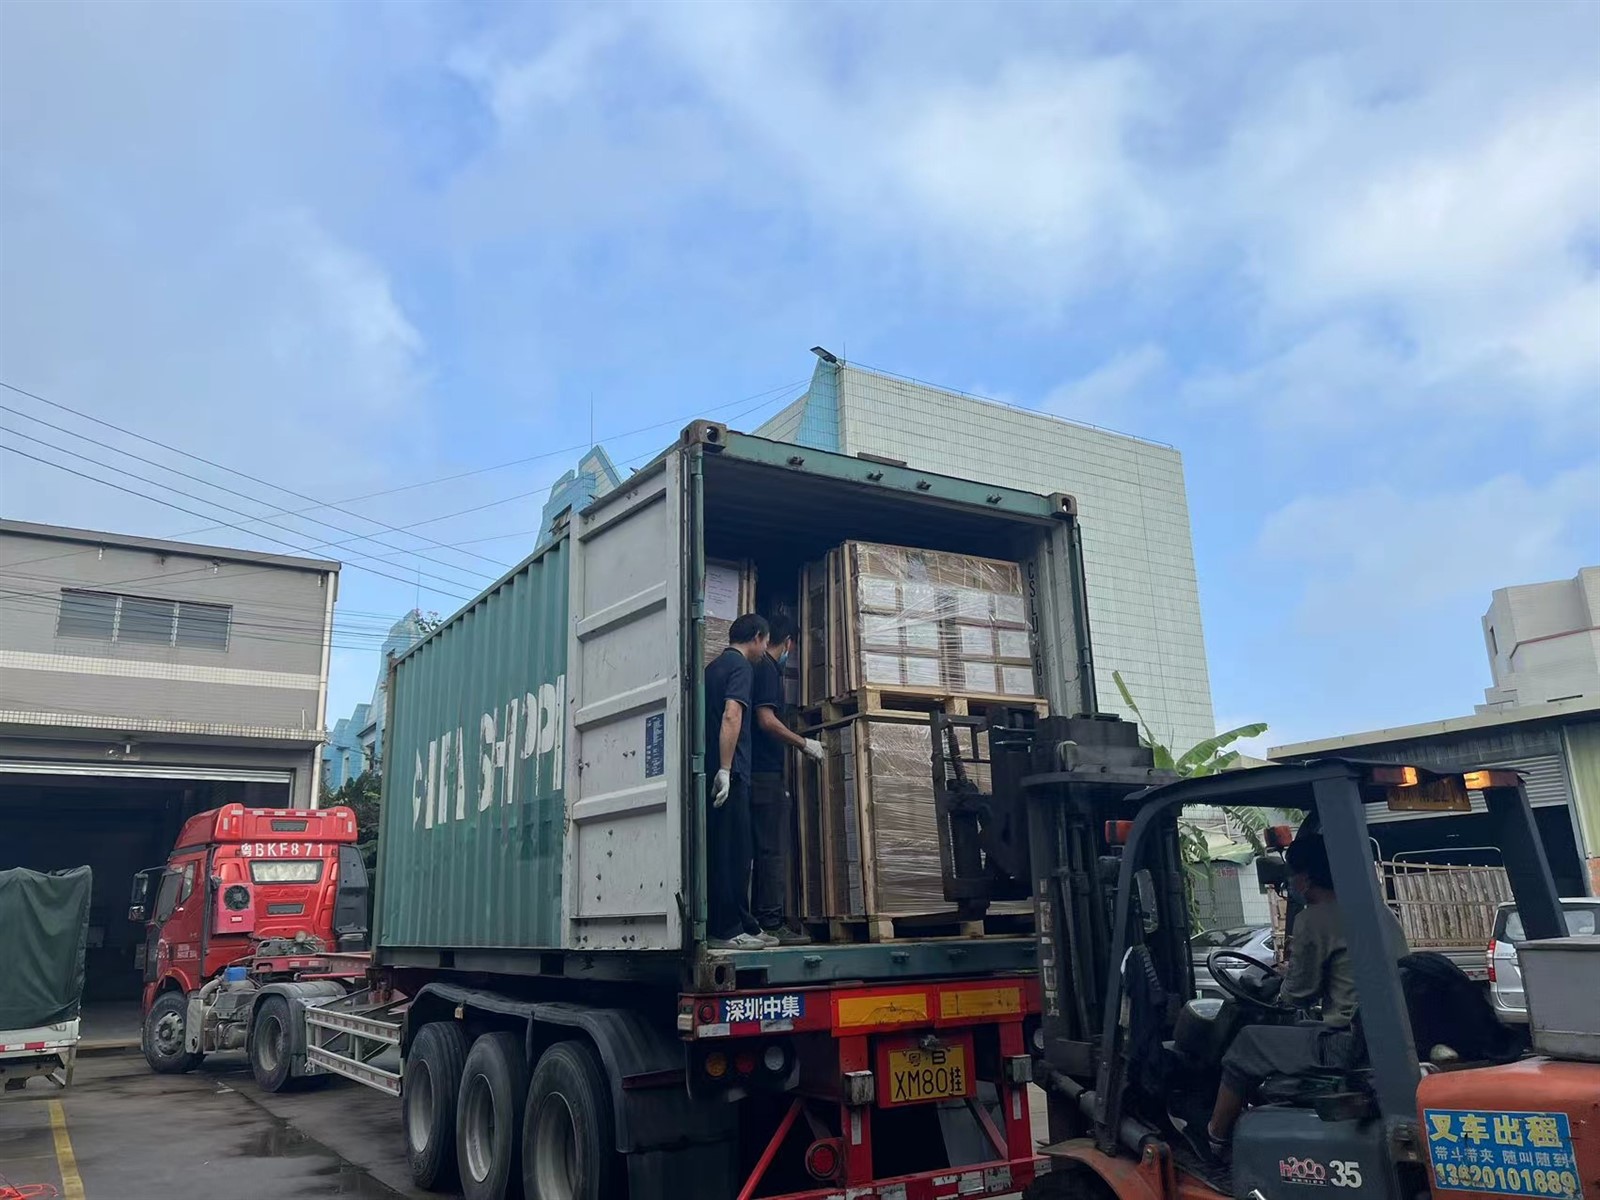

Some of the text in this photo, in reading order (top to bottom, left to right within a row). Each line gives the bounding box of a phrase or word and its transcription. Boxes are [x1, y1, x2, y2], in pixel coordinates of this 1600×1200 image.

[725, 995, 800, 1022] 深圳中集
[1429, 1113, 1564, 1148] 叉车出租
[1329, 1160, 1362, 1188] 35
